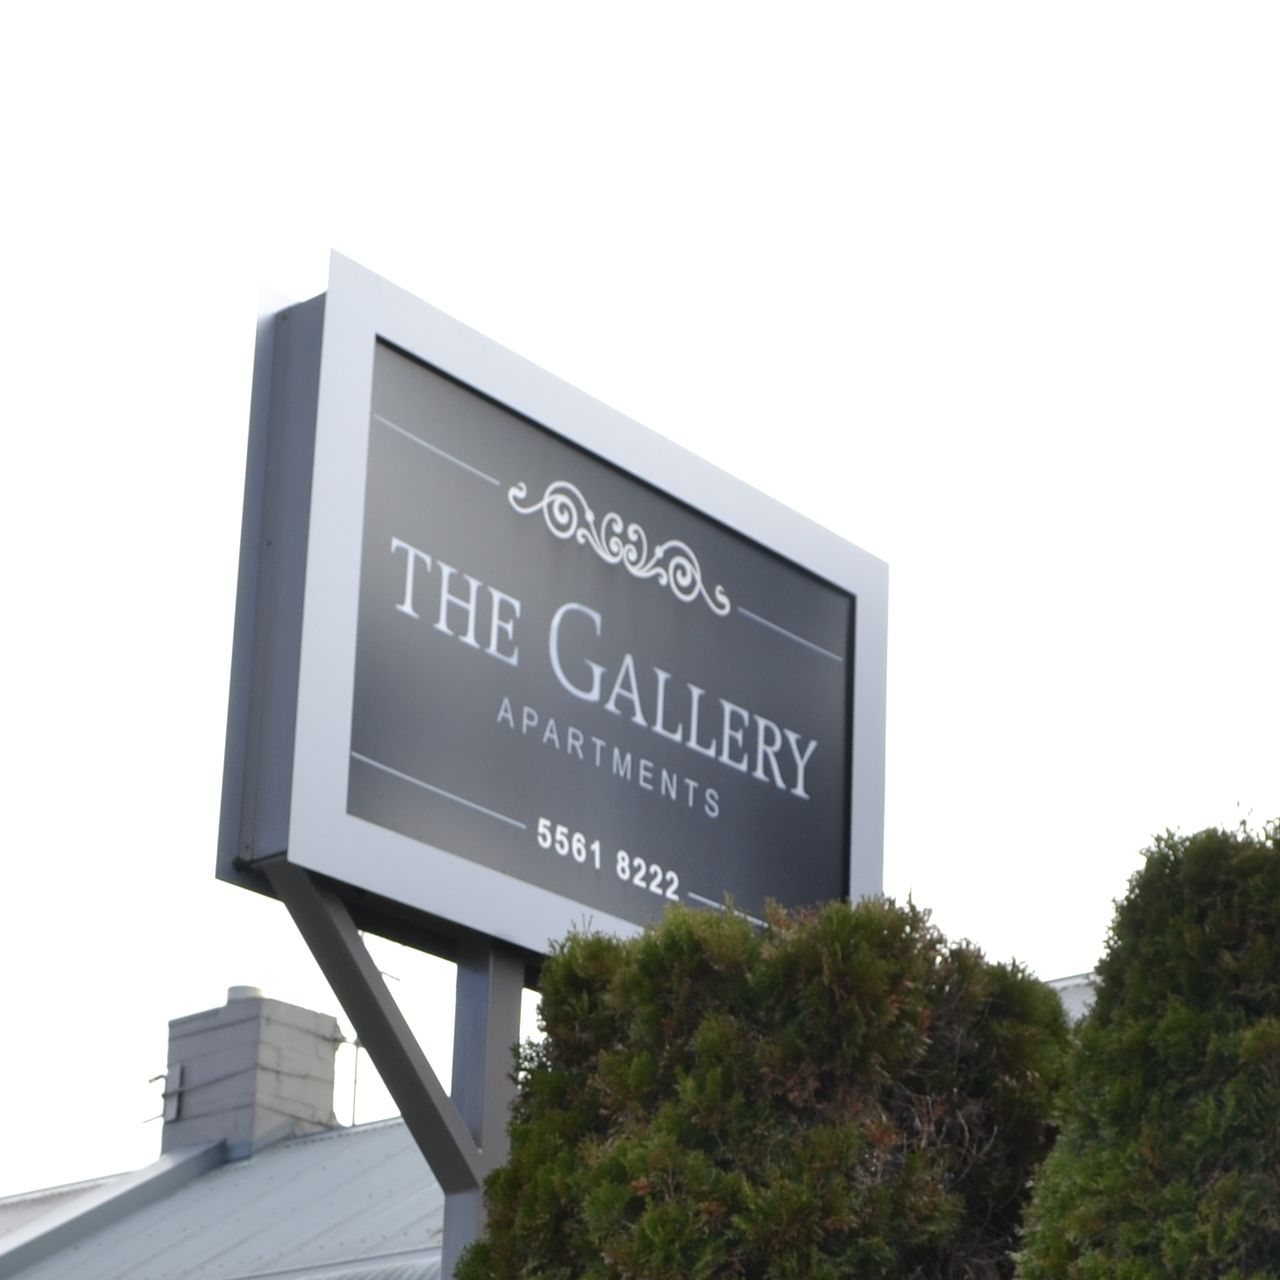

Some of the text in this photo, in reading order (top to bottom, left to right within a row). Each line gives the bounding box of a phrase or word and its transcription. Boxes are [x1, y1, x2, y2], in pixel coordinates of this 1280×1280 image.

[391, 536, 818, 800] THE GALLERY
[497, 697, 720, 818] APARTMENTS
[536, 817, 680, 900] 5561 8222
